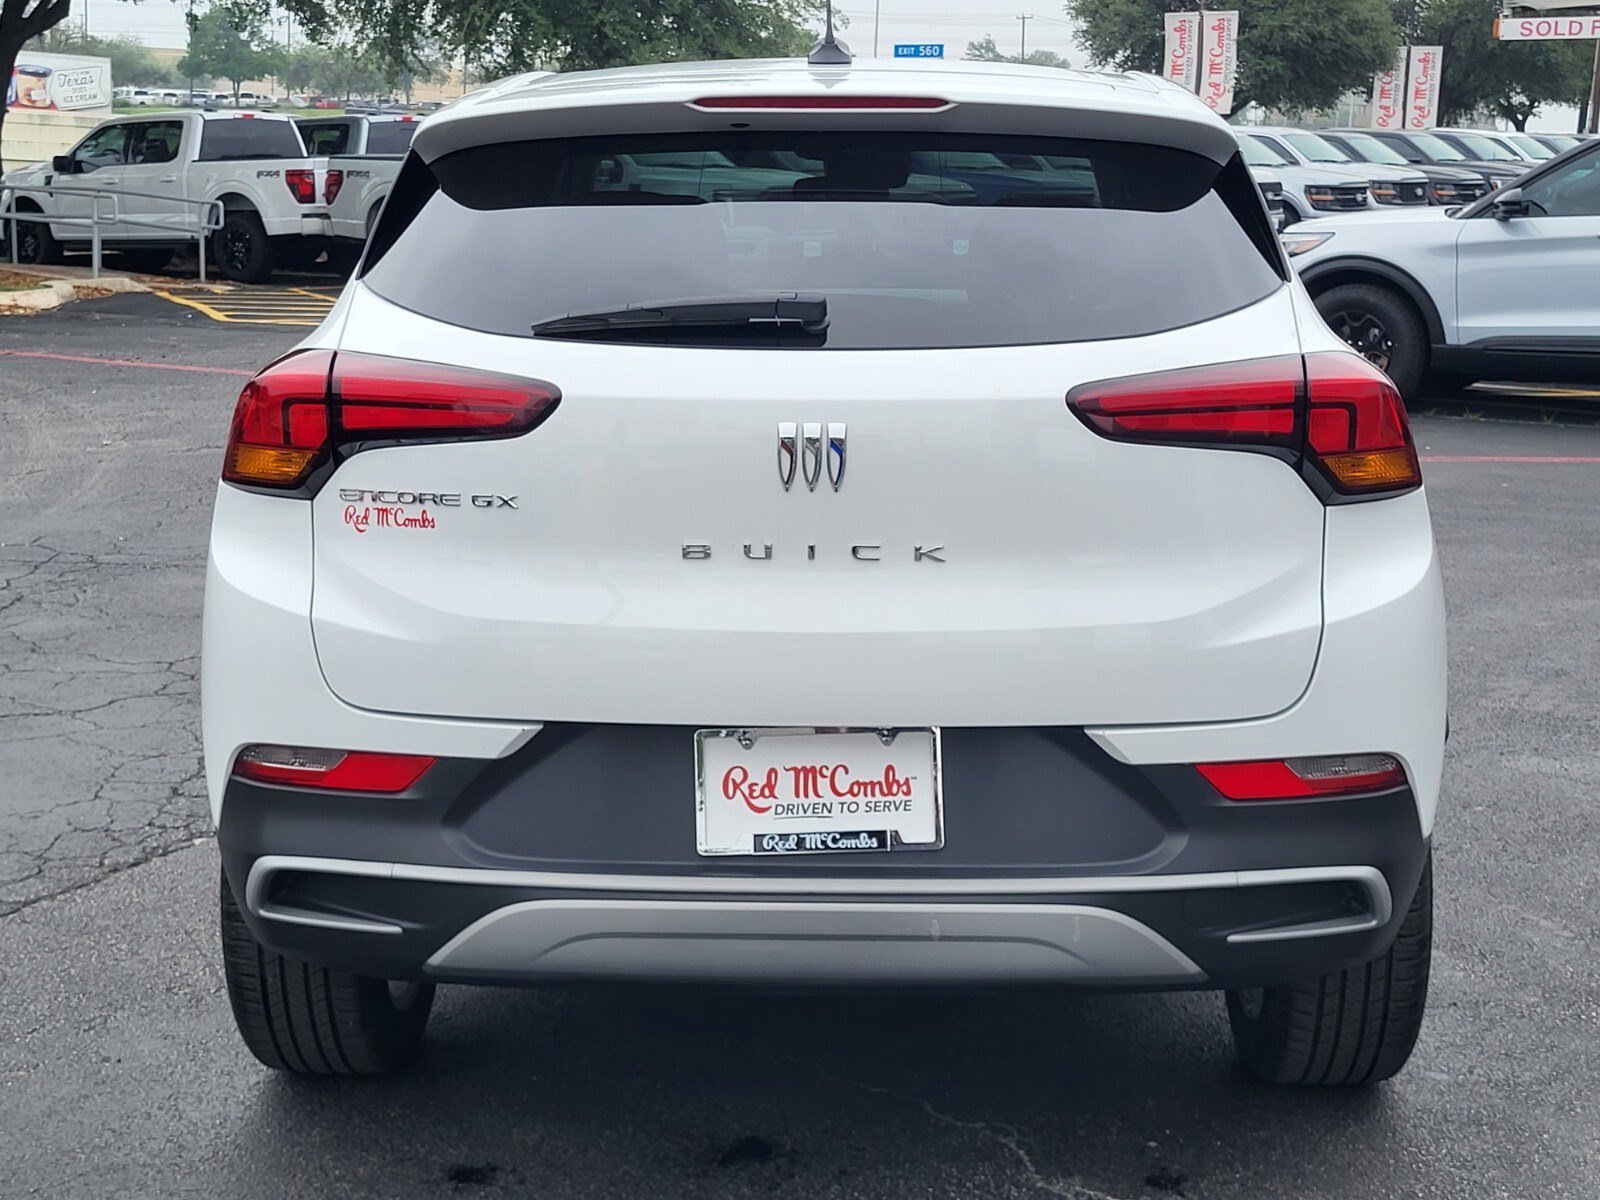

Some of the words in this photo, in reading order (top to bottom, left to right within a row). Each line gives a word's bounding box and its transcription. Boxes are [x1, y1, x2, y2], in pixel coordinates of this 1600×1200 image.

[1520, 20, 1583, 37] SOLD
[898, 47, 915, 55] EXIT
[918, 45, 940, 56] 560
[1170, 18, 1187, 79] McCombs
[1209, 18, 1226, 79] McCombs
[58, 74, 94, 88] Texas
[339, 488, 461, 507] ENCORE
[471, 494, 519, 510] GX
[344, 504, 370, 533] Red
[373, 506, 436, 529] McCombs
[681, 544, 947, 563] BUICK
[722, 765, 779, 814] Red
[783, 763, 912, 800] McCombs
[774, 801, 833, 816] DRIVEN
[838, 801, 859, 814] TO
[864, 799, 913, 814] SERVE
[762, 833, 798, 851] Red
[799, 832, 878, 850] McCombs
